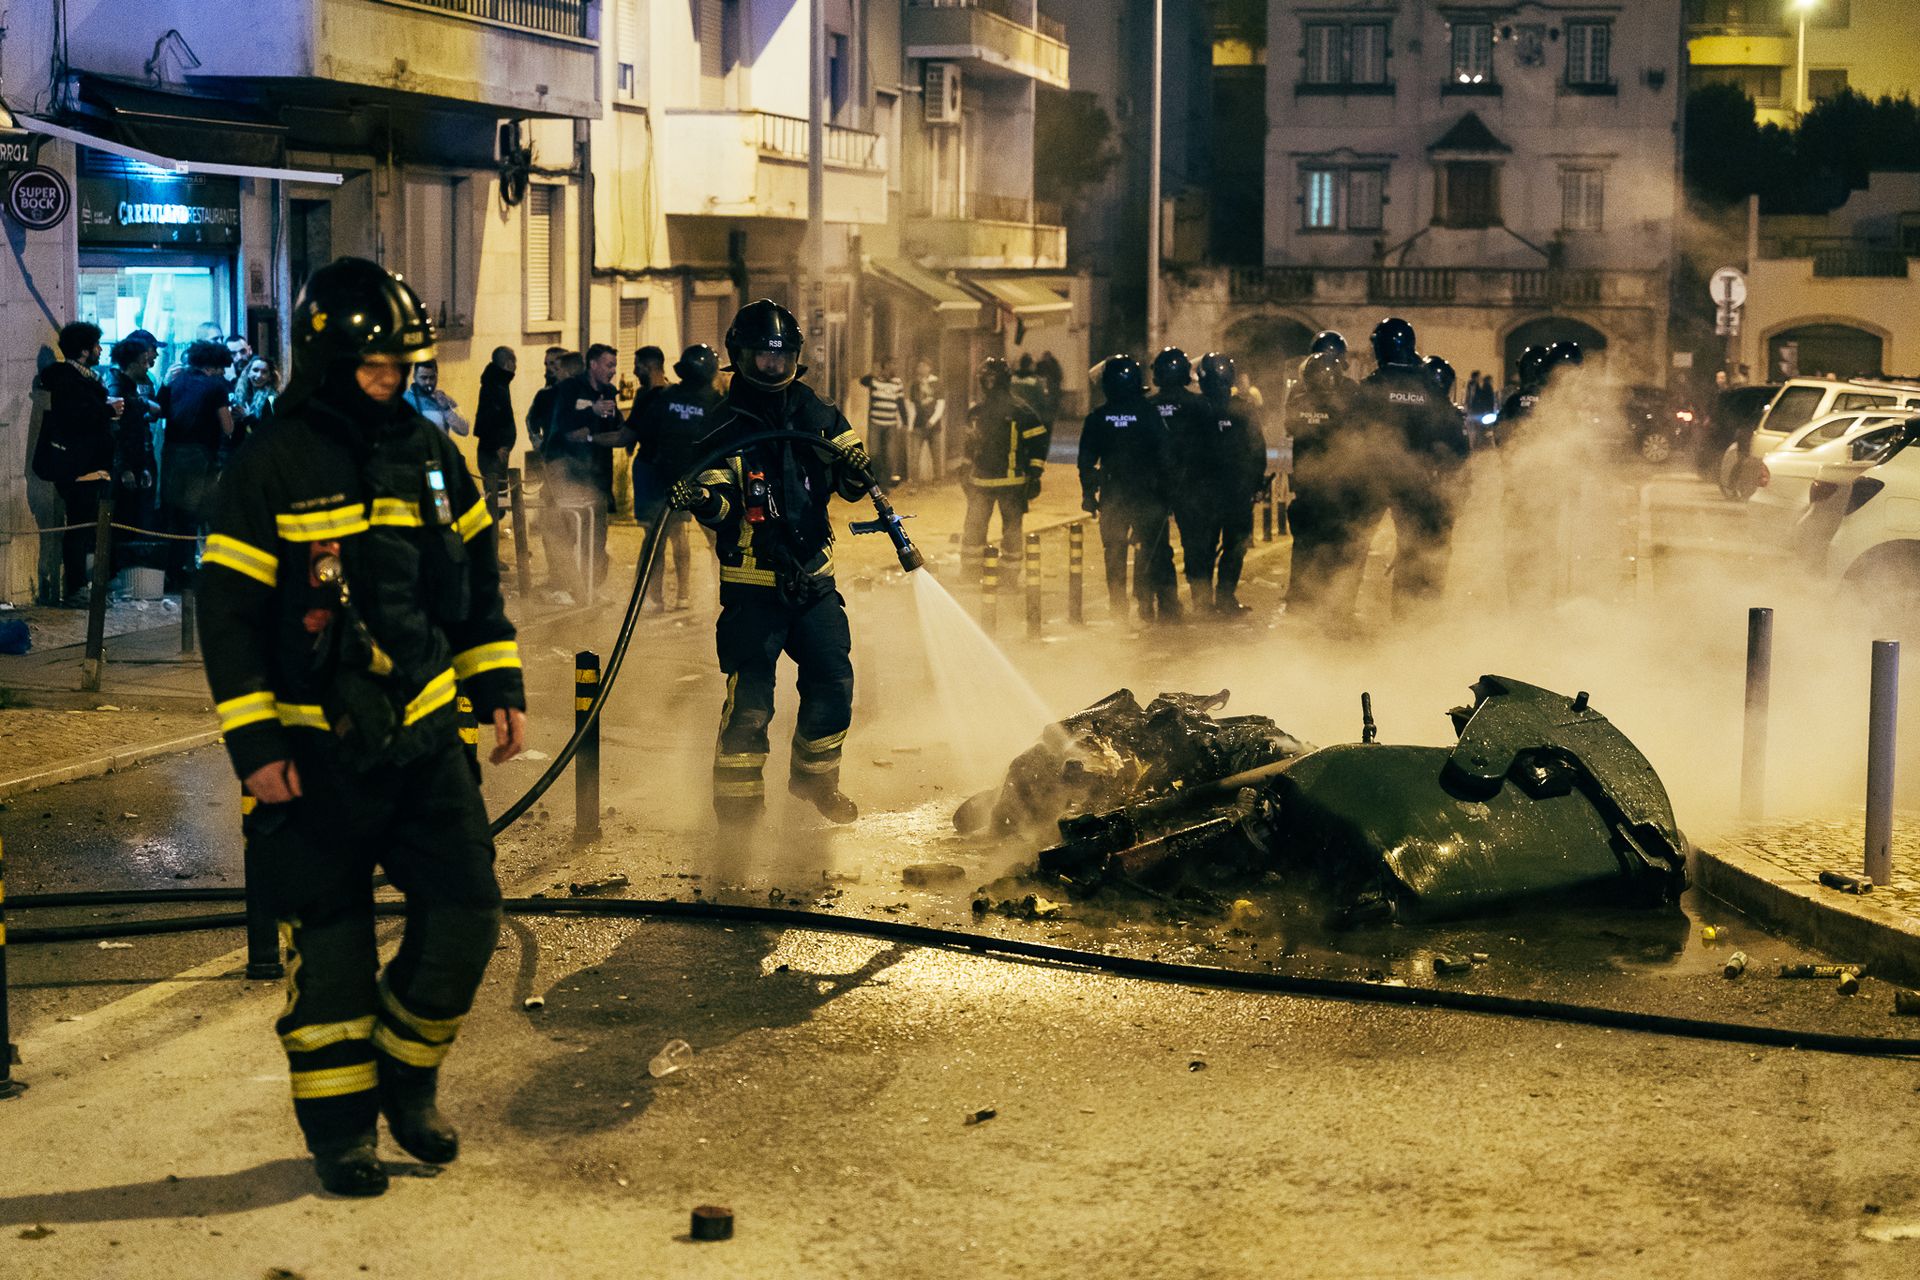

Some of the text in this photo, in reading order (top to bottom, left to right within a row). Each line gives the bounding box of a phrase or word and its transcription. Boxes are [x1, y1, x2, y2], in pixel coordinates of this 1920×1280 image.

[18, 186, 57, 198] SUPER
[20, 197, 55, 209] BOCK
[188, 206, 238, 225] RESTAURANTE
[769, 340, 783, 348] RSB
[1389, 392, 1425, 402] POLÍCIA
[669, 402, 704, 416] POLÍCIA
